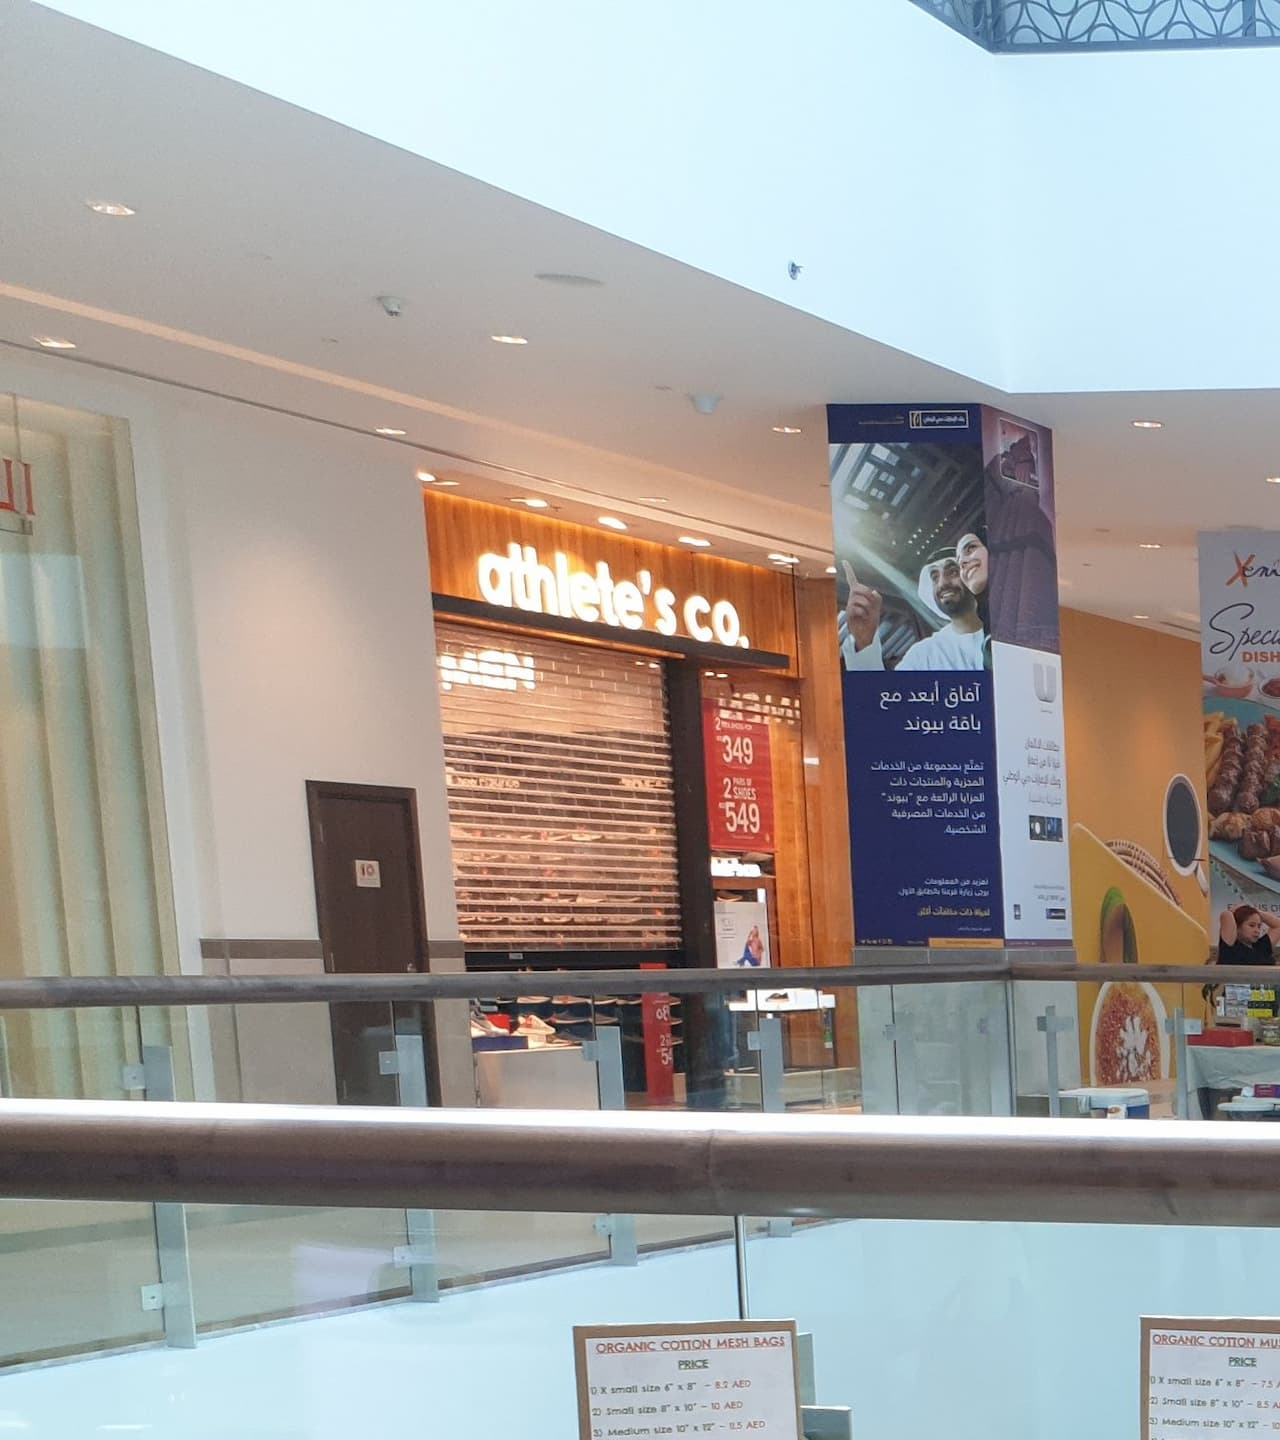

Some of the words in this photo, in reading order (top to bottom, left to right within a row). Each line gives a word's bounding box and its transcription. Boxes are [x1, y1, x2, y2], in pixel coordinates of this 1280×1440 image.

[478, 542, 677, 636] athlete's
[684, 595, 749, 649] co.
[880, 691, 901, 710] مع
[908, 681, 939, 705] أبعد
[945, 682, 981, 708] آفاق
[904, 716, 944, 734] بيوند
[949, 714, 981, 734] باقة
[723, 737, 753, 765] 349
[724, 778, 732, 799] 2
[733, 786, 756, 801] SHOES
[725, 803, 760, 833] 549
[596, 1342, 655, 1353] ORGANIC
[661, 1339, 711, 1350] COTTON
[716, 1338, 749, 1349] MESH
[754, 1337, 785, 1348] BAGS
[1152, 1334, 1204, 1346] ORGANIC
[1209, 1337, 1255, 1348] COTTON
[678, 1360, 708, 1370] PRICE
[1229, 1357, 1256, 1367] PRICE
